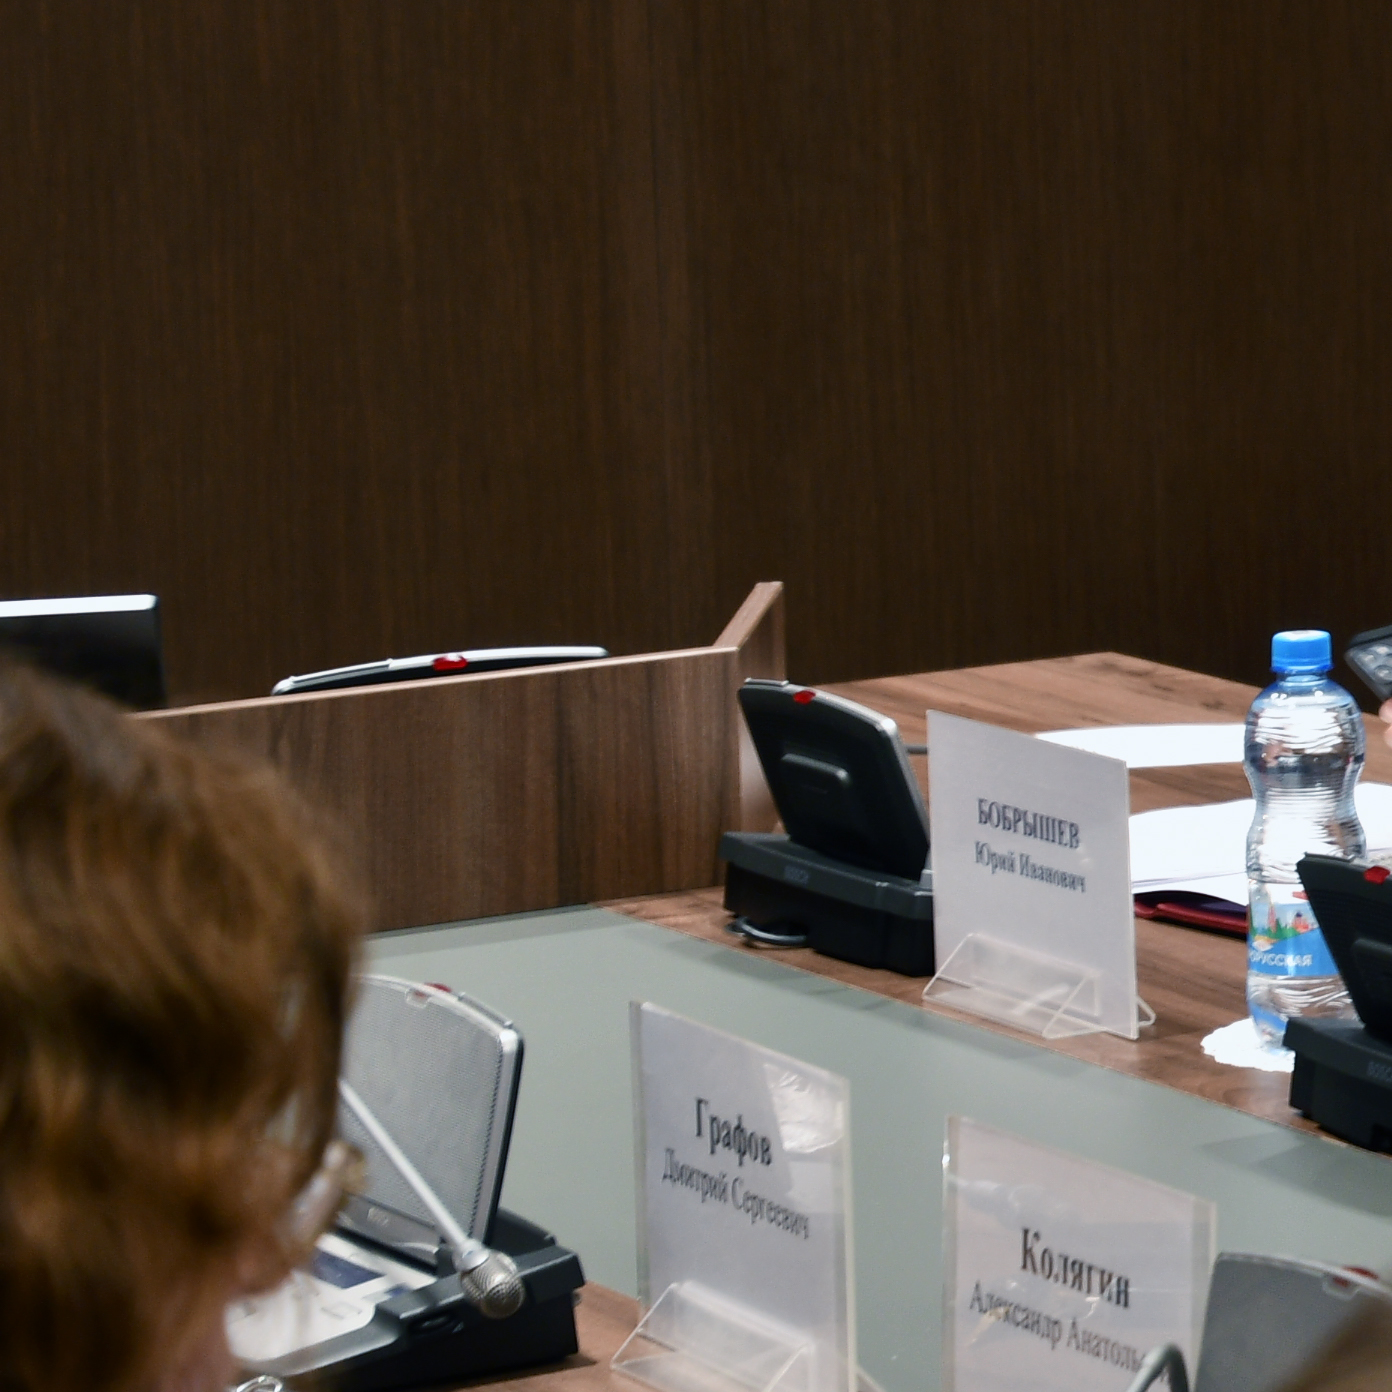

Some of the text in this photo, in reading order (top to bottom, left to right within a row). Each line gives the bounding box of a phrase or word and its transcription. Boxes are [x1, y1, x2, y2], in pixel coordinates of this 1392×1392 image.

[977, 797, 1081, 850] БОБРЫШЕВ
[975, 841, 1086, 893] Юрий Иванович
[695, 1098, 773, 1167] Графов
[661, 1147, 811, 1240] Дмитрий Сергеевич
[1020, 1227, 1131, 1309] Колягин
[969, 1279, 1063, 1351] Александр
